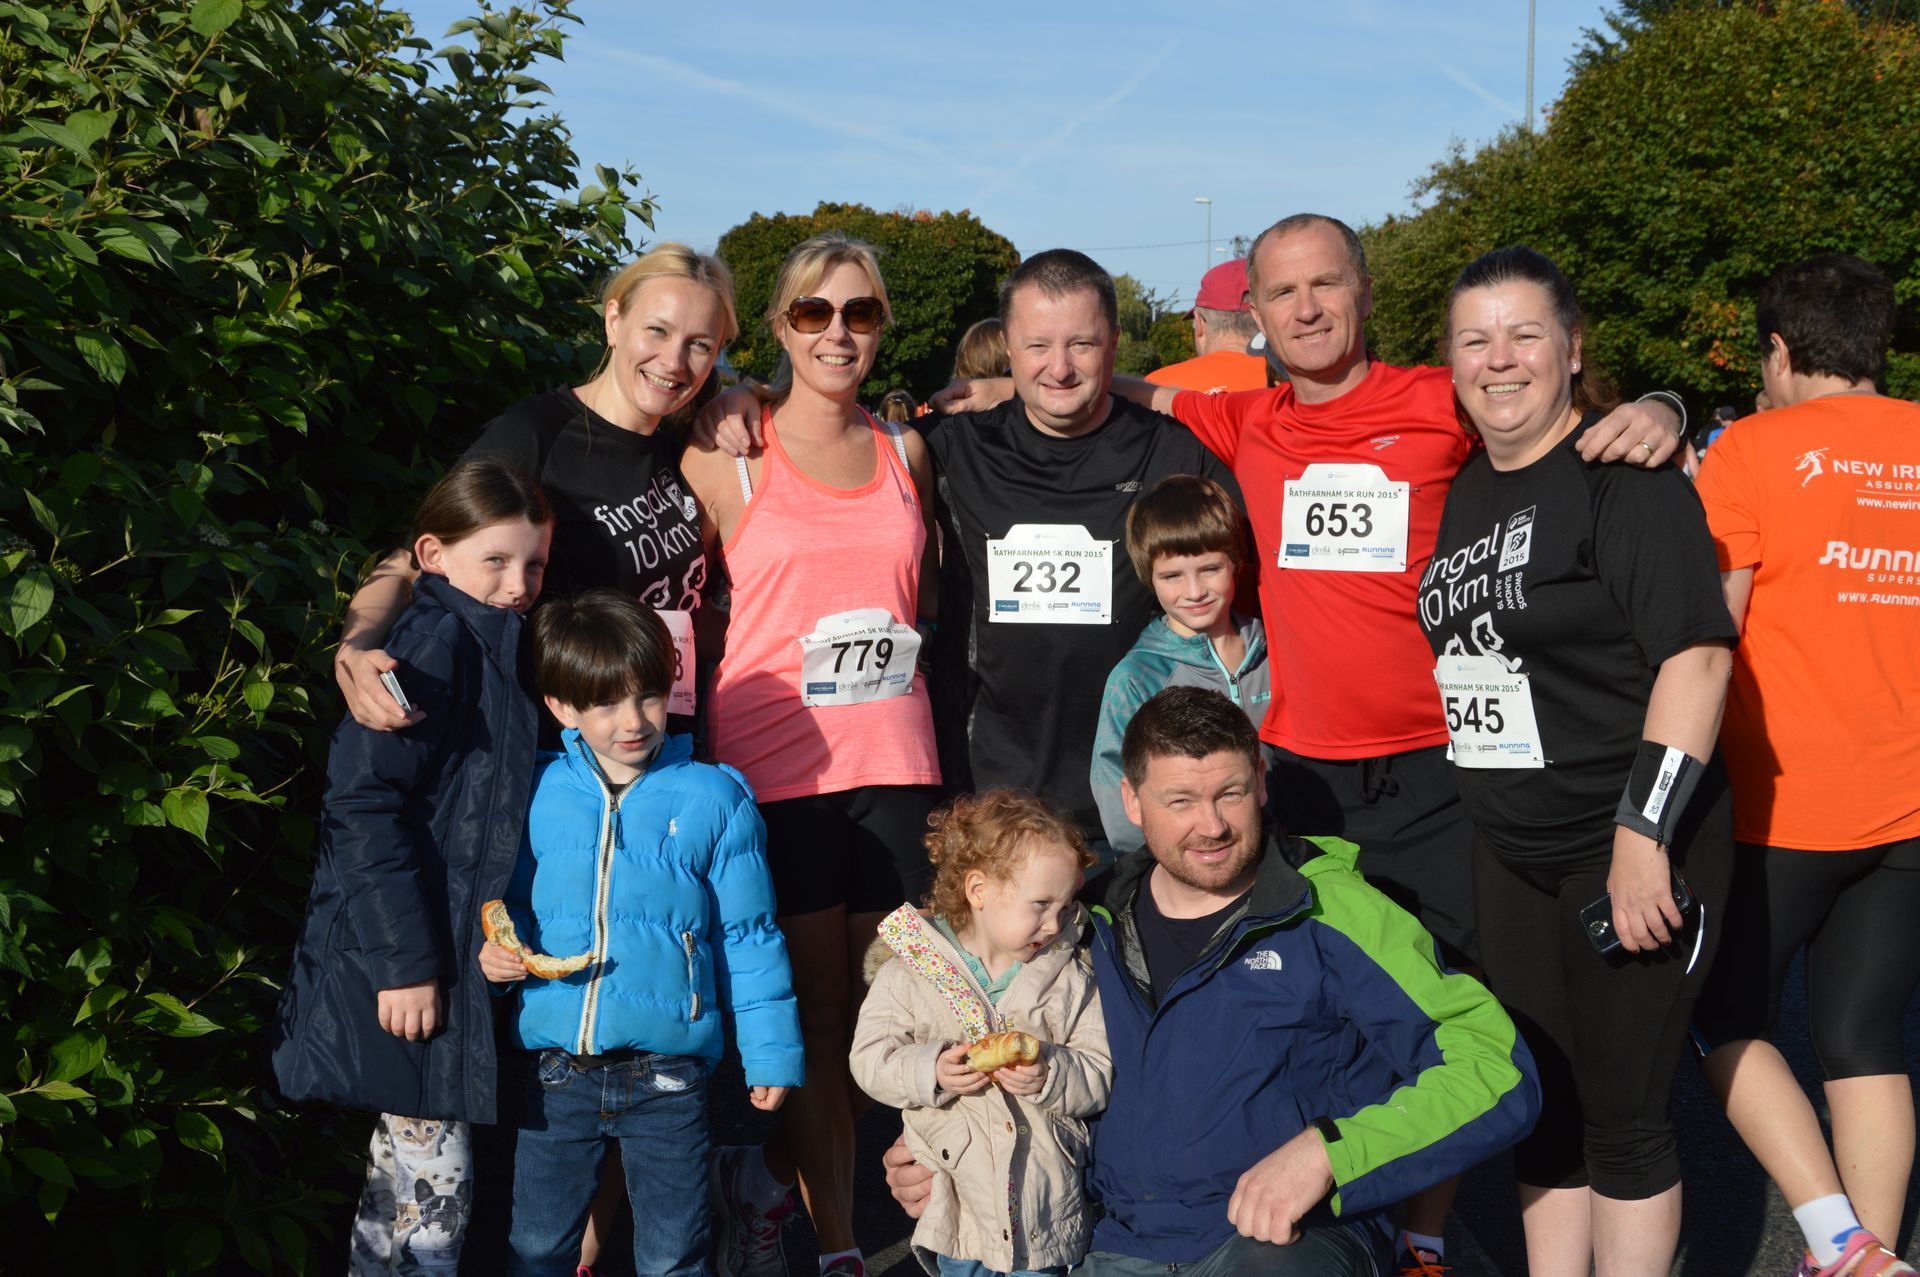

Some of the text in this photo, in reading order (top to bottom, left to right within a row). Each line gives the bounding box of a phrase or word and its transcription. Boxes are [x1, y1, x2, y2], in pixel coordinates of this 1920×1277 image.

[1832, 459, 1884, 477] NEW
[594, 477, 672, 536] fingal
[1344, 490, 1354, 498] 5K
[1377, 491, 1399, 499] 2015
[1306, 502, 1373, 538] 653
[624, 533, 659, 575] 10
[654, 522, 698, 560] km
[1084, 550, 1103, 558] 2015
[1503, 552, 1525, 567] 2015
[1012, 561, 1081, 594] 232
[1495, 578, 1504, 610] JULY 19
[1505, 574, 1516, 610] SUNDAY
[1515, 571, 1528, 610] SWORDS
[1418, 573, 1489, 632] 10 km
[831, 637, 894, 674] 779
[1475, 684, 1485, 692] 5K
[1485, 684, 1500, 692] RUN
[1501, 684, 1520, 693] 2015
[1446, 696, 1505, 734] 545
[1244, 957, 1267, 965] NORTH
[1256, 950, 1269, 958] THE
